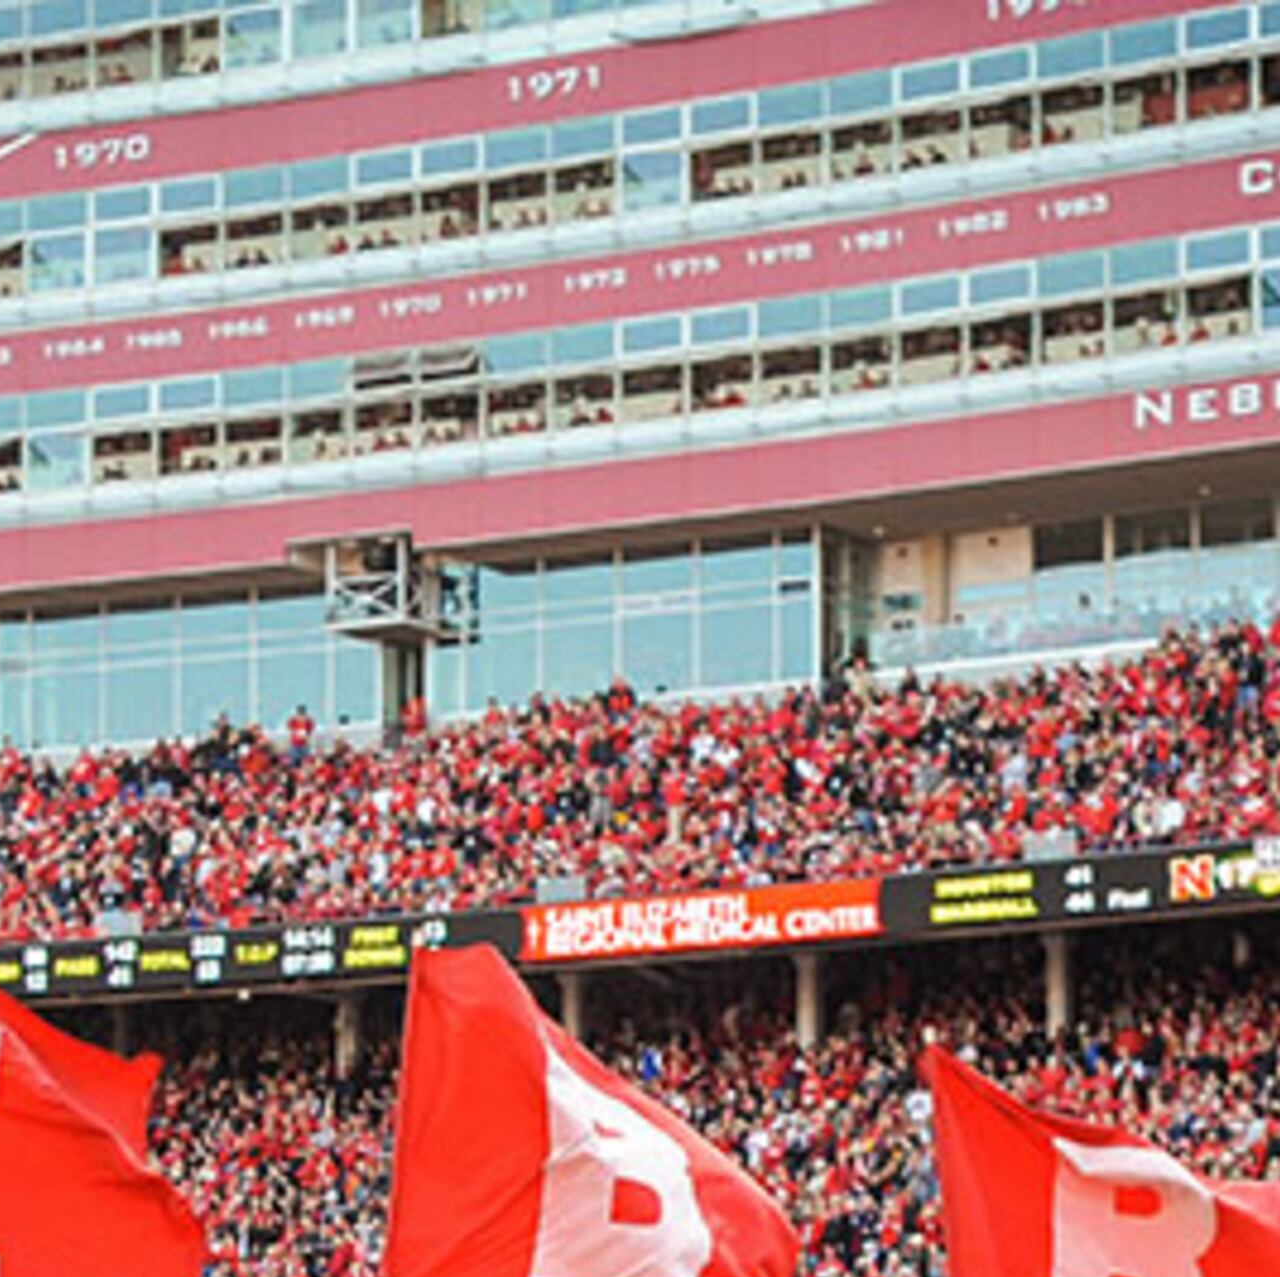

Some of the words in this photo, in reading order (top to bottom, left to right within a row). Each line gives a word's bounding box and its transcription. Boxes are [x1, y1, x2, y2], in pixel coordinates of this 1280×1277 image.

[506, 64, 602, 102] 1971
[52, 133, 150, 169] 1970
[467, 282, 529, 306] 1971
[784, 904, 881, 937] CENTER
